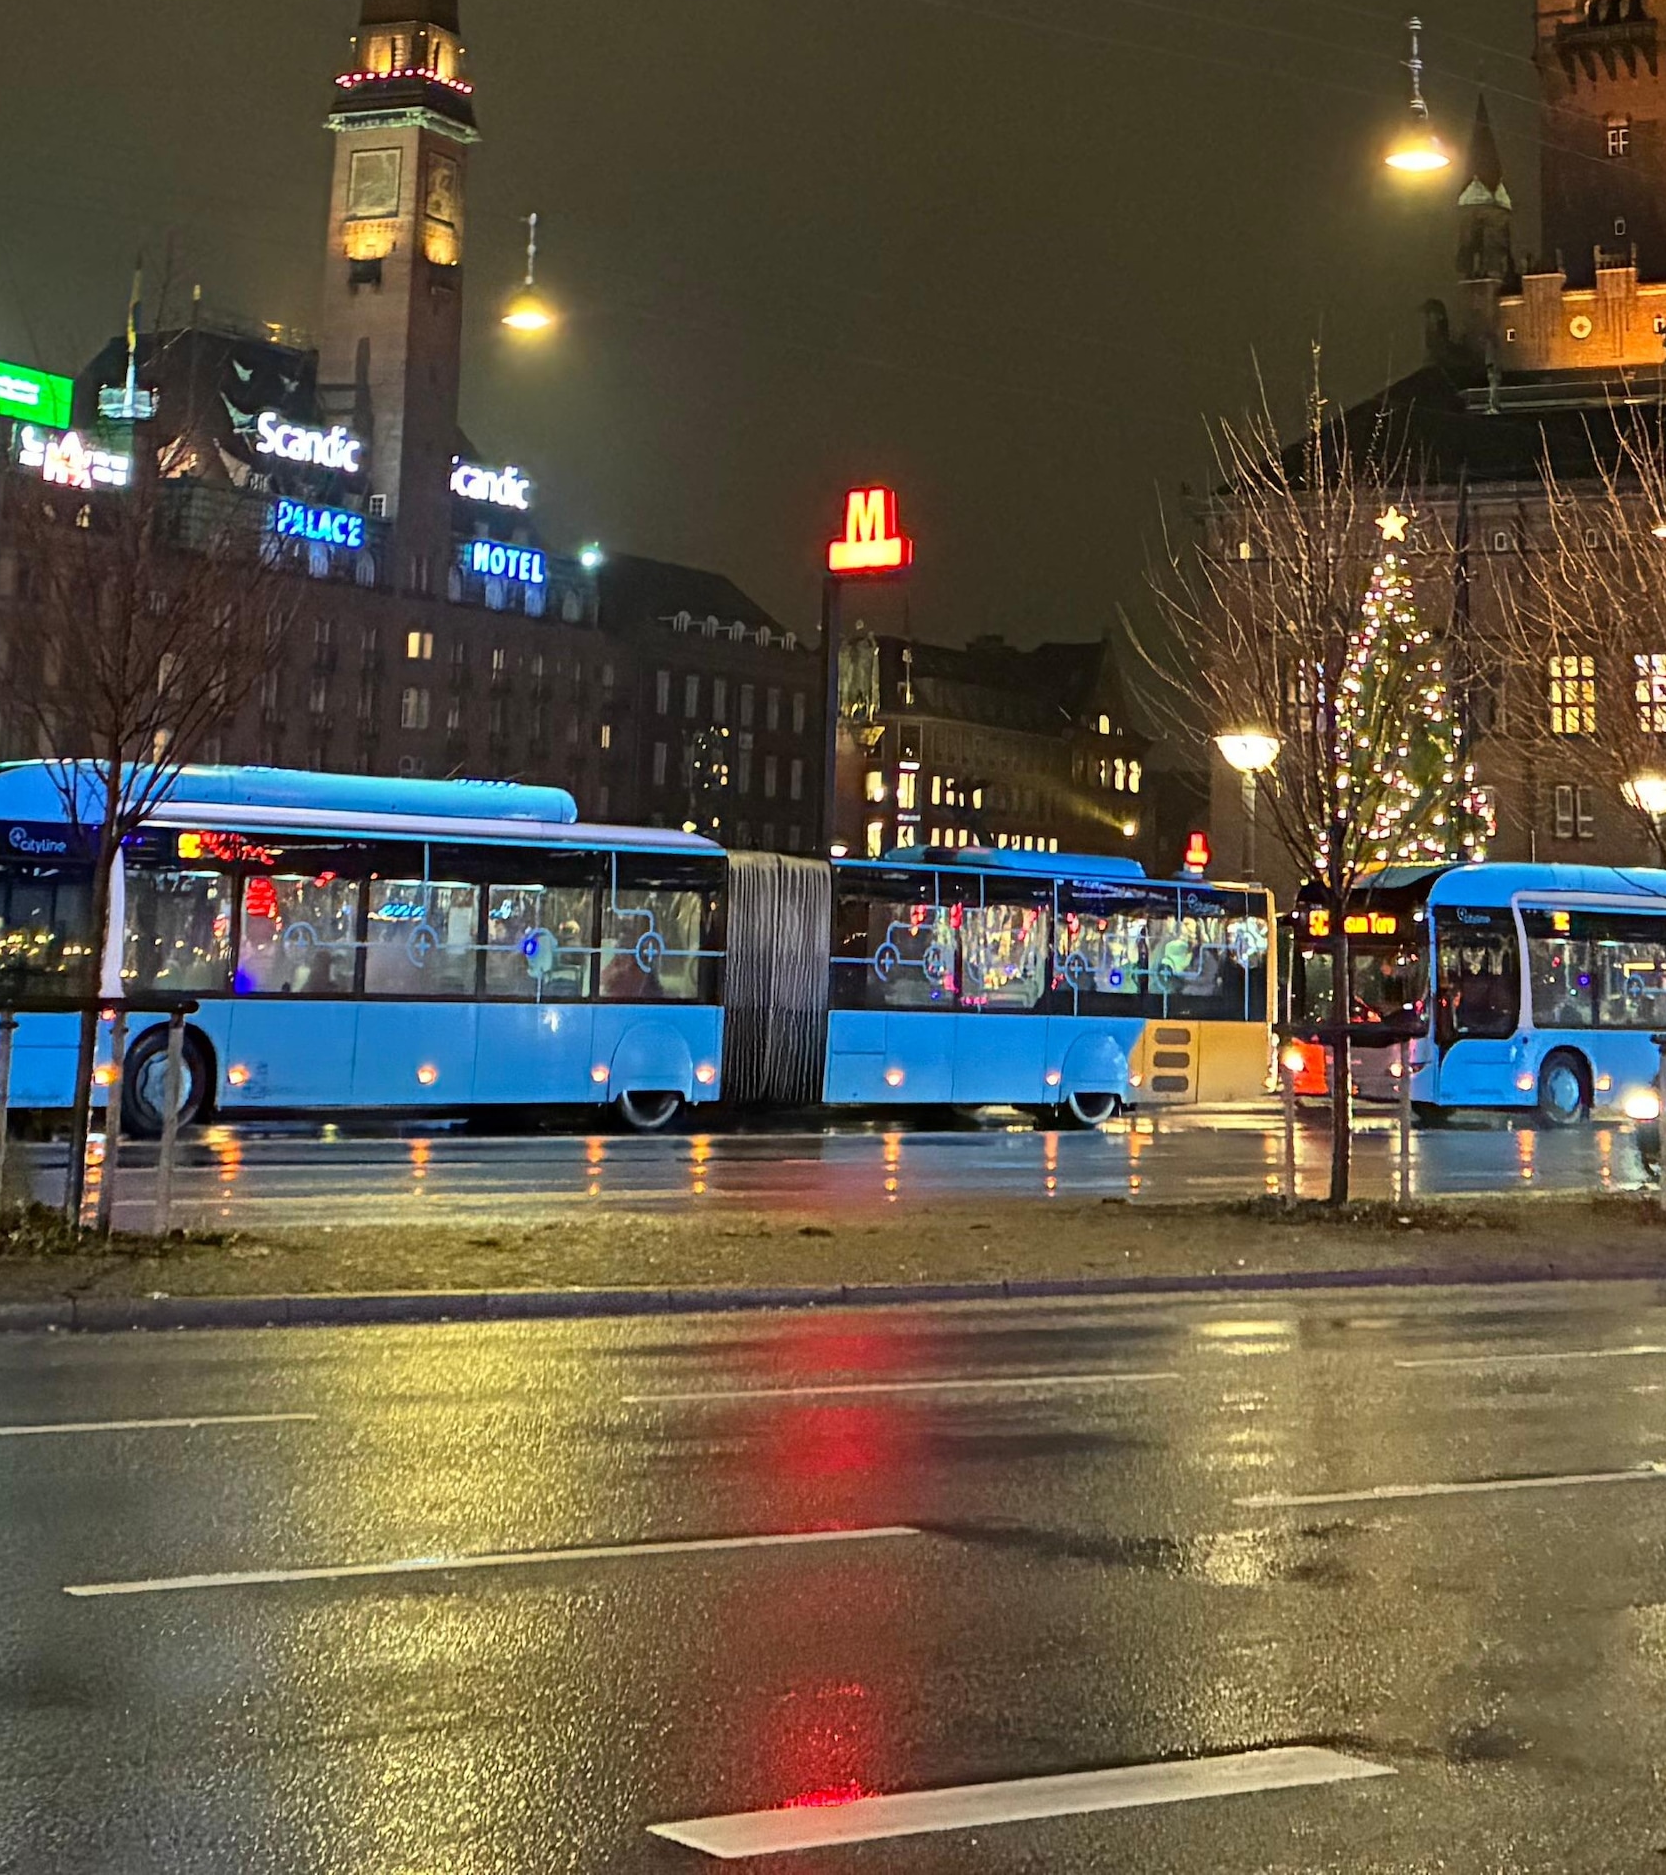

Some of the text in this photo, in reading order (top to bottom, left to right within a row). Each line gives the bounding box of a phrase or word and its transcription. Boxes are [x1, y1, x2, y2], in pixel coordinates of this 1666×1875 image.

[256, 411, 361, 474] Scandic
[450, 456, 530, 510] candic
[277, 500, 364, 547] PALACE
[473, 541, 545, 584] HOTEL
